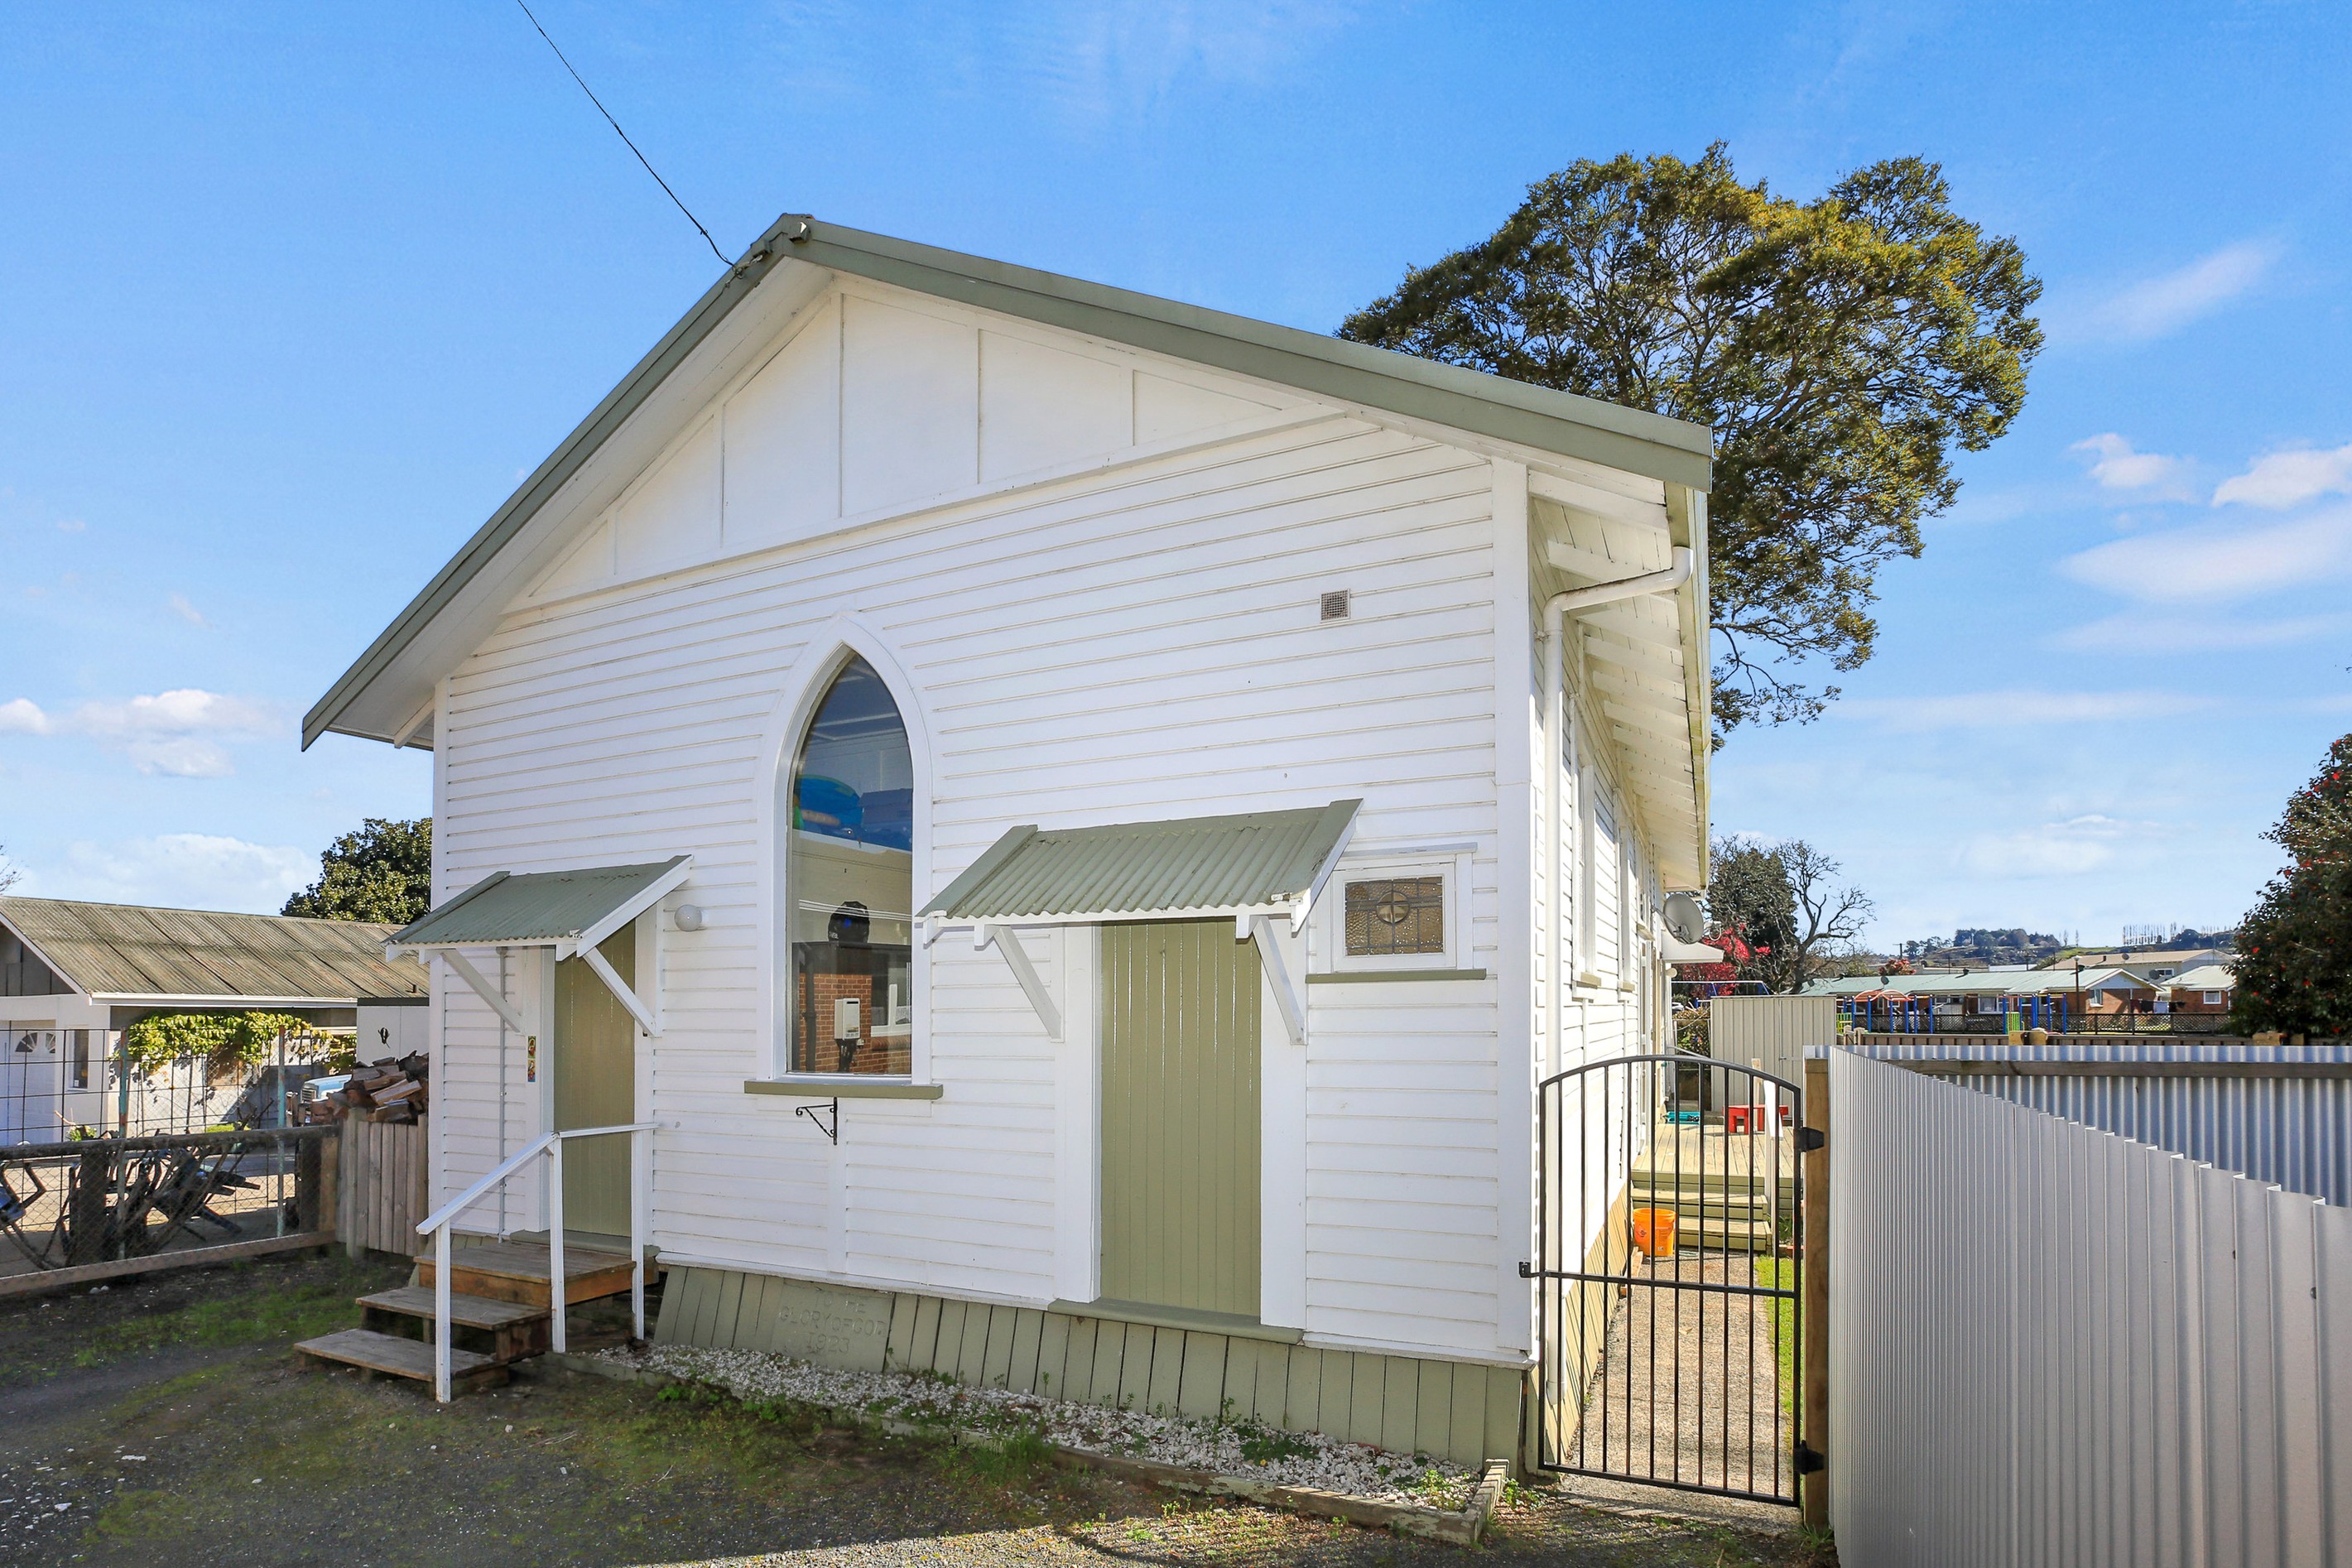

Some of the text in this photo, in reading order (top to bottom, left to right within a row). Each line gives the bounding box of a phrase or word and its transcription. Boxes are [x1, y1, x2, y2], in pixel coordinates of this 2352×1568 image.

[778, 1305, 887, 1338] GLORY OF GOD
[806, 1331, 850, 1354] 1923
